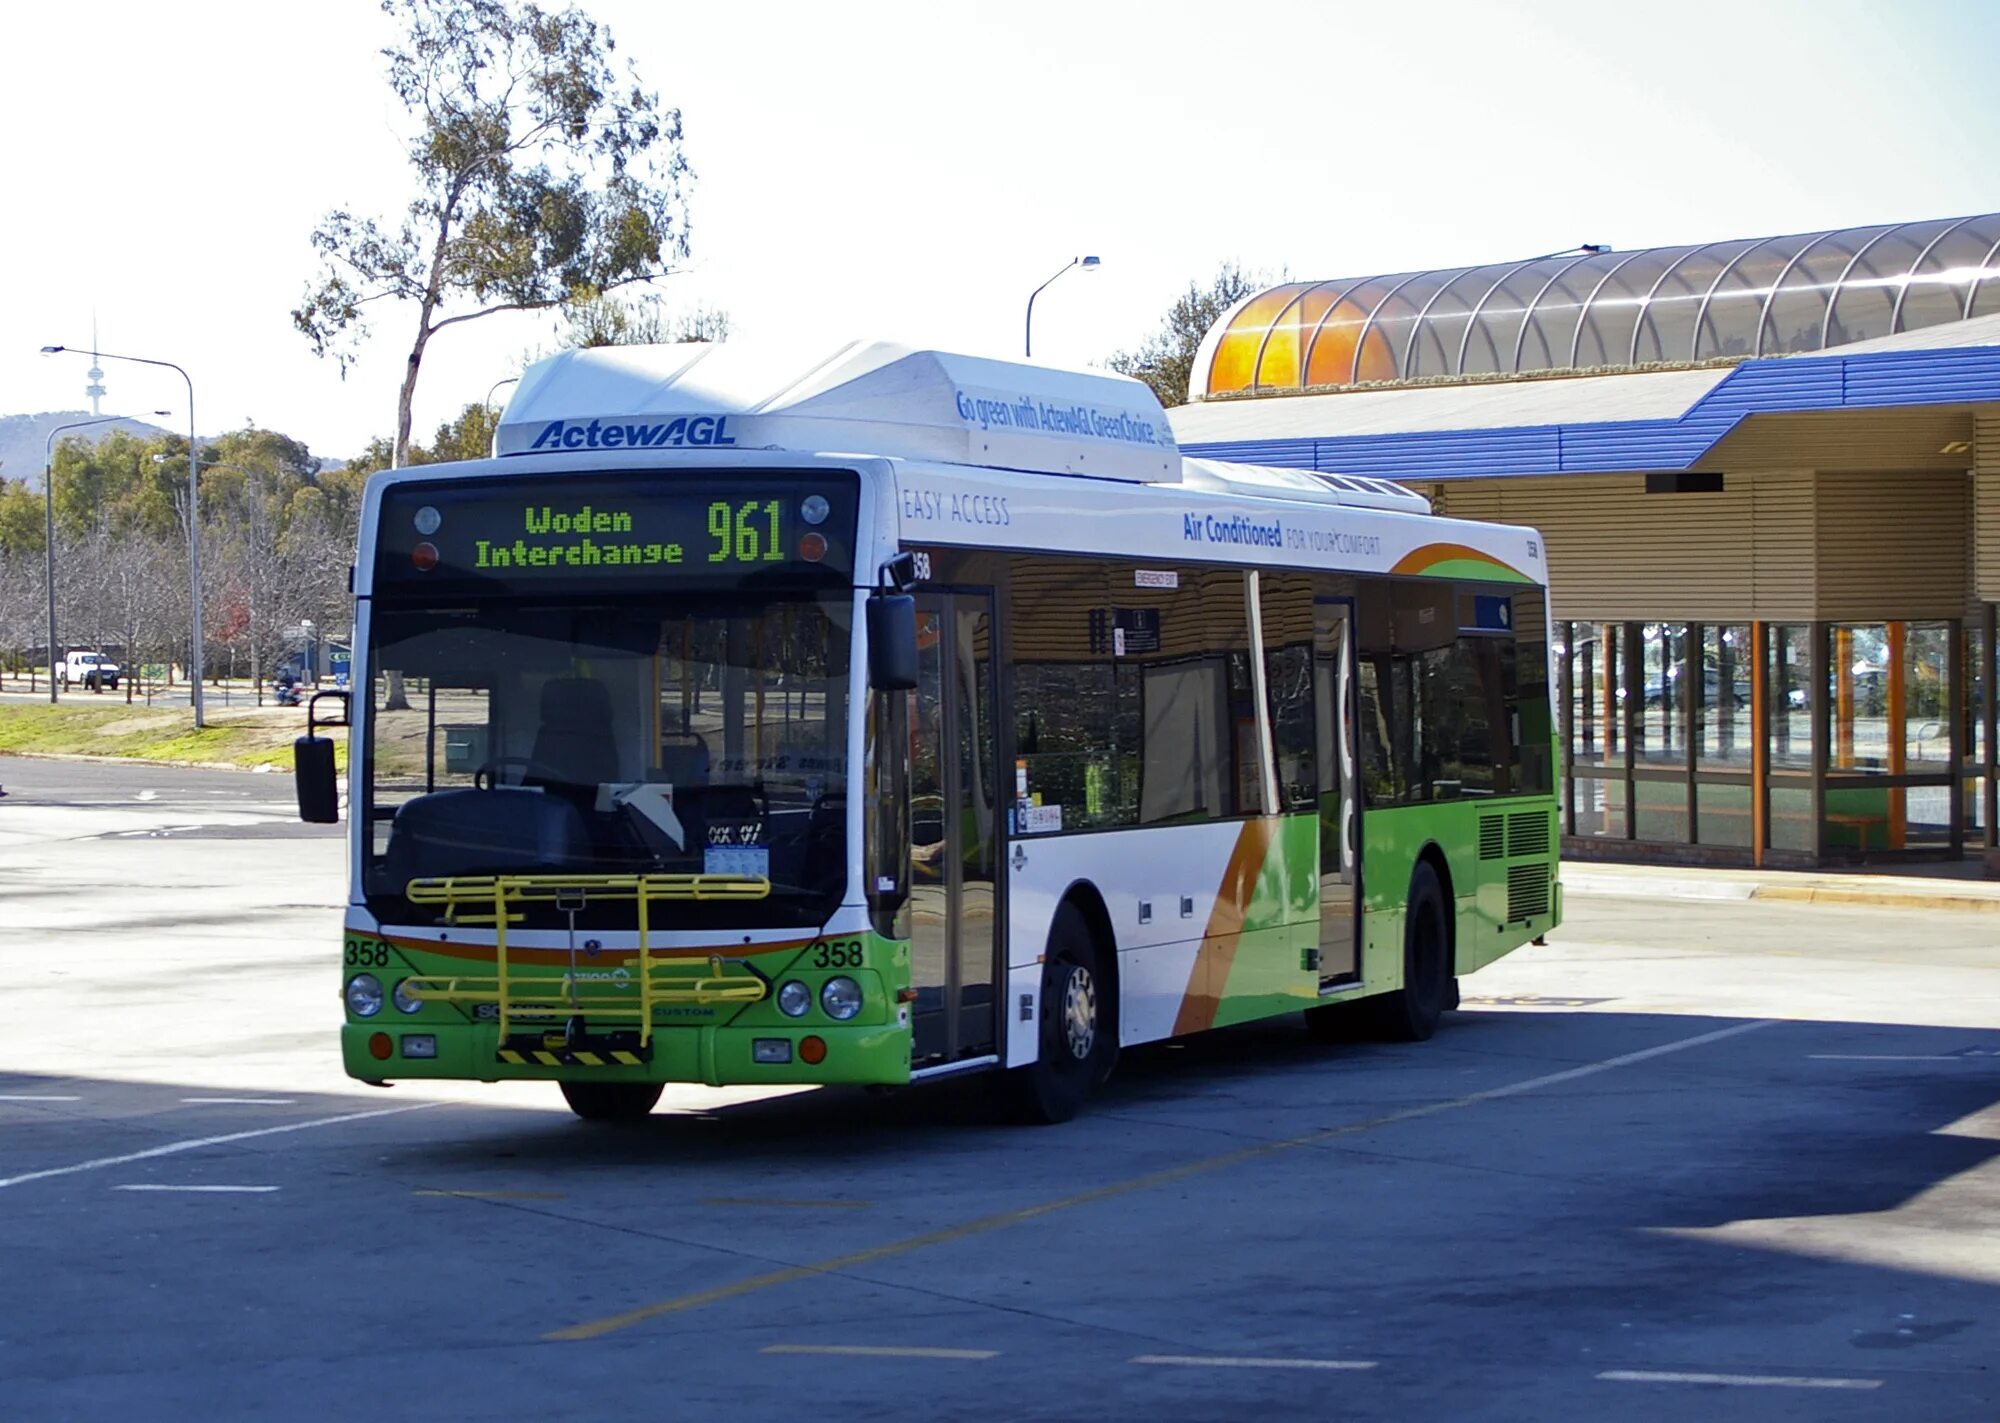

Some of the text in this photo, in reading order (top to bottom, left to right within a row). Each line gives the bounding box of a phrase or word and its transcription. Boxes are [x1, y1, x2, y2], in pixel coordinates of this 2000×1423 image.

[530, 416, 735, 449] ActewAGL
[956, 391, 976, 422] Go
[976, 396, 1011, 431] green
[1010, 396, 1041, 430] with
[1091, 409, 1156, 445] GreenChoice
[525, 506, 632, 534] Woden
[903, 489, 1010, 526] EASY ACCESS
[708, 500, 785, 562] 961
[1184, 512, 1203, 542] Air
[1206, 514, 1282, 548] Conditioned
[1286, 528, 1304, 550] FOR
[475, 539, 683, 568] Interchange
[345, 940, 389, 968] 358
[813, 940, 864, 968] 358
[653, 1007, 716, 1017] CUSTOM
